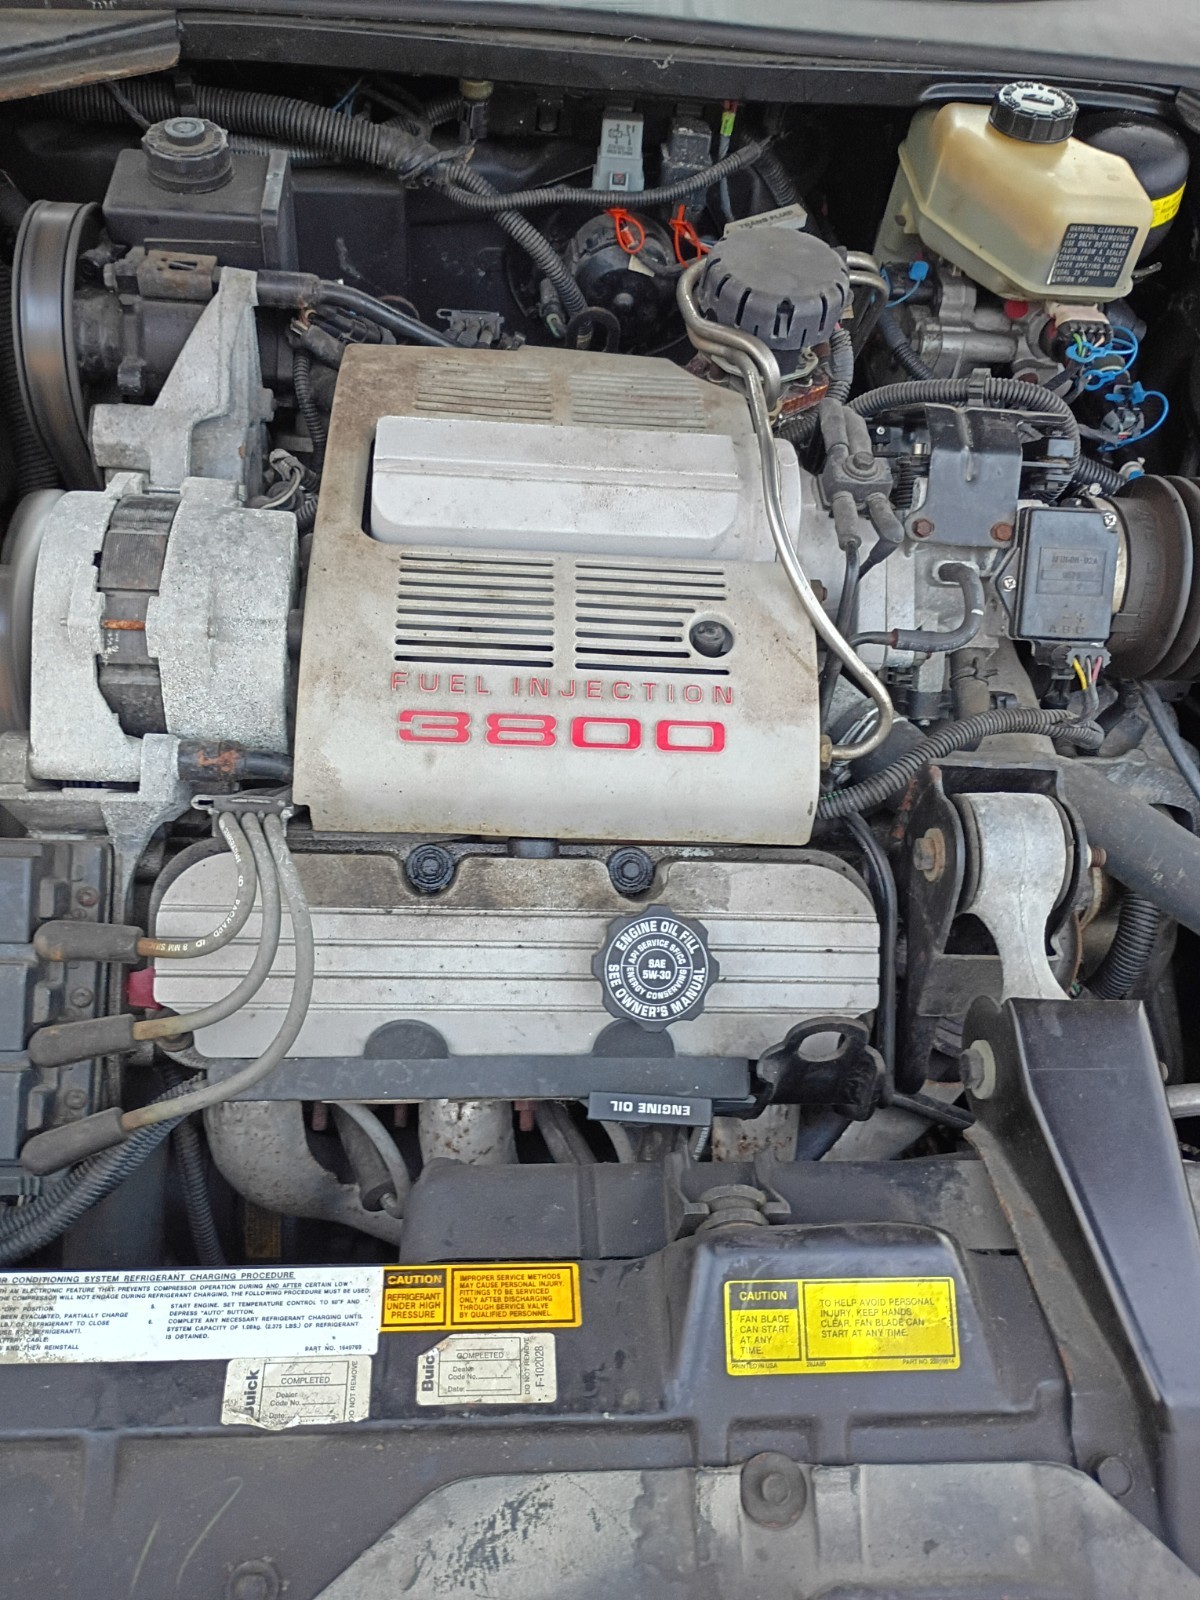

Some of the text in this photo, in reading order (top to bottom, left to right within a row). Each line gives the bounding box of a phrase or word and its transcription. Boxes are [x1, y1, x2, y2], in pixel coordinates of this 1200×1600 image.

[391, 671, 733, 705] FUEL INJECTION
[398, 710, 725, 753] 3800
[615, 921, 699, 954] ENGINE OIL FILL
[628, 939, 686, 965] API SERVICE SF/CC
[648, 959, 666, 968] SAE
[642, 970, 671, 980] 5W-30
[626, 967, 687, 999] ENERGY CONSERVING
[608, 964, 705, 1017] SEE OWNER'S MANUAL
[610, 1101, 691, 1116] ENGINE OIL
[12, 1276, 79, 1284] CONDITIONING
[124, 1274, 185, 1282] REFRIGERANT
[387, 1275, 442, 1285] CAUTION
[387, 1292, 441, 1301] REFRIGERANT
[739, 1291, 787, 1300] CAUTION
[387, 1302, 416, 1310] UNDER
[835, 1299, 856, 1307] HELP
[860, 1298, 886, 1306] AVOID
[889, 1298, 935, 1306] PERSONAL
[391, 1311, 435, 1319] PRESSURE
[471, 1310, 507, 1318] QUALIFIED
[882, 1308, 912, 1316] HANDS
[761, 1315, 790, 1323] BLADE
[875, 1318, 904, 1326] BLADE
[906, 1318, 924, 1326] CAN
[762, 1325, 789, 1333] START
[821, 1330, 849, 1338] START
[866, 1329, 883, 1337] ANY
[740, 1336, 752, 1344] AT
[534, 1345, 544, 1387] F-102028
[350, 1361, 358, 1391] REMOVE
[524, 1384, 530, 1394] DO
